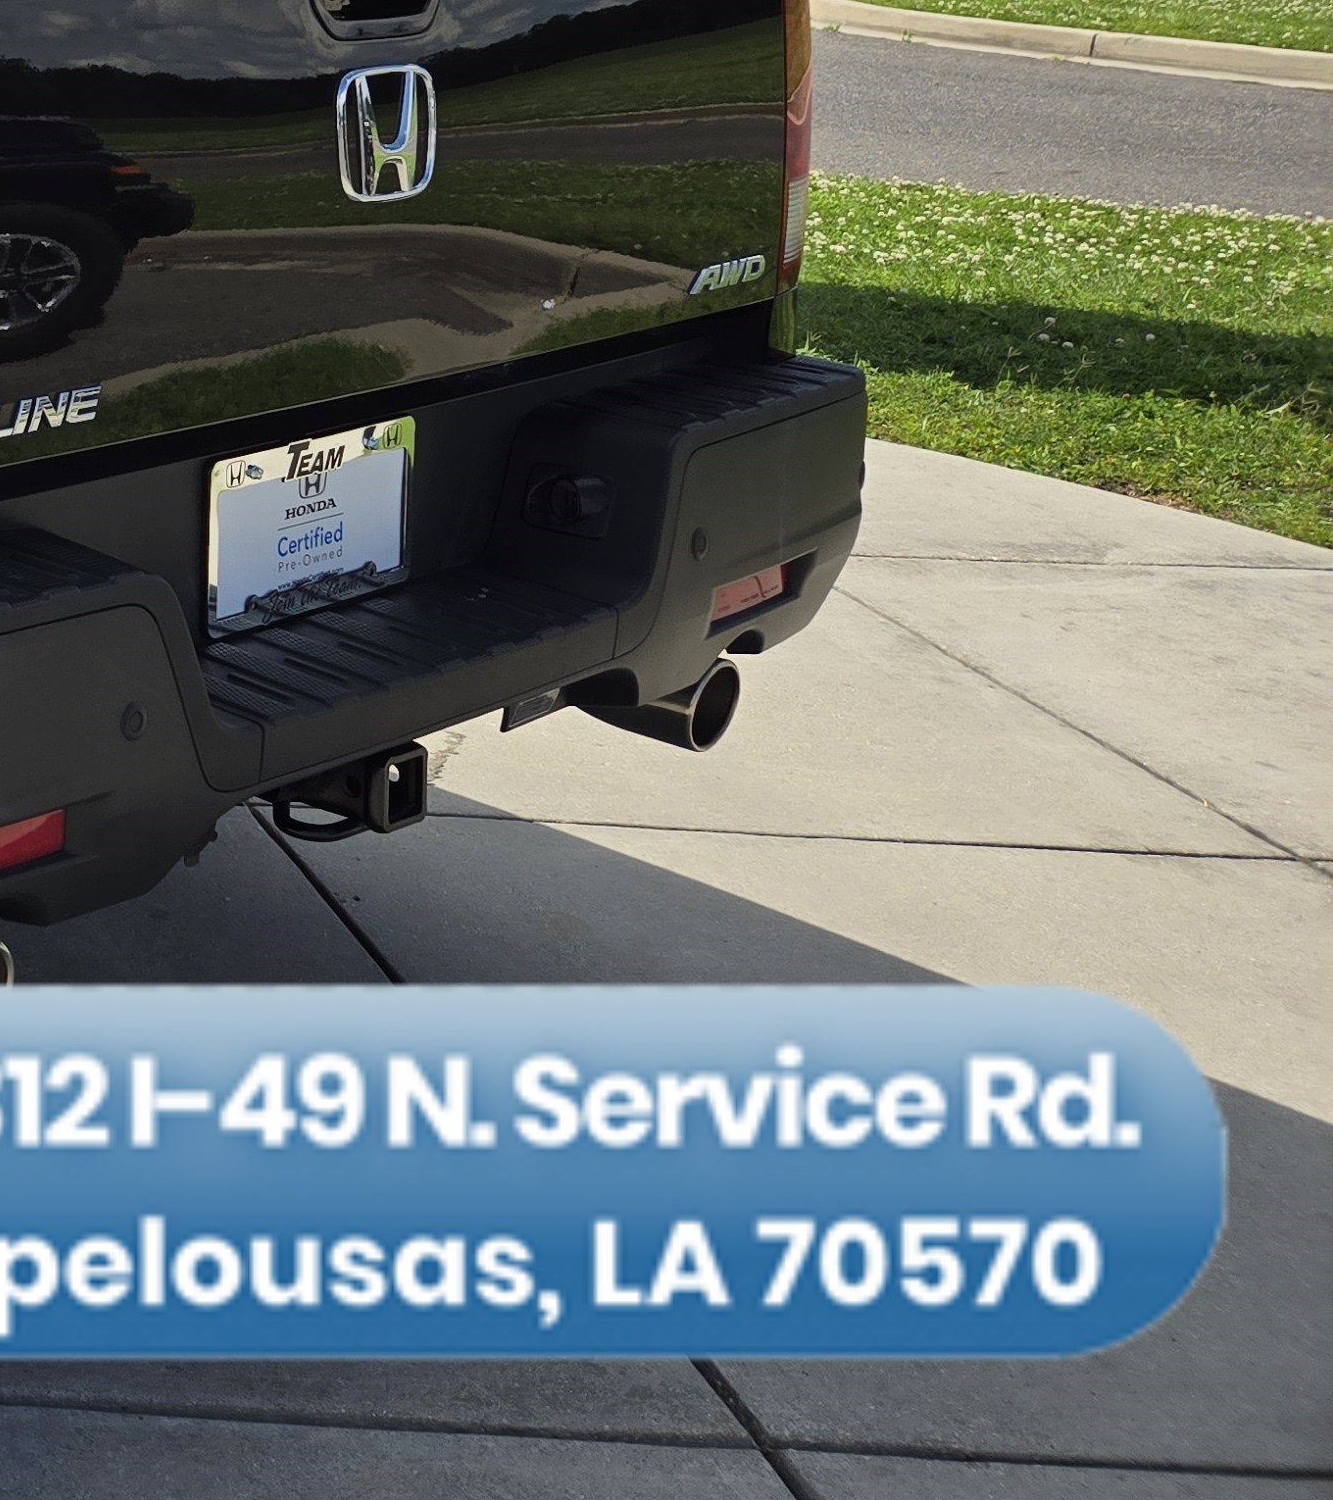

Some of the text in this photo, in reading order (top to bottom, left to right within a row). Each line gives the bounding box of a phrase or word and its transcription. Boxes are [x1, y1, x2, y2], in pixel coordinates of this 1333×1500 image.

[689, 254, 766, 296] AWD
[285, 440, 346, 482] TEAM
[285, 498, 337, 520] HONDA
[277, 521, 343, 558] Certified
[277, 547, 343, 573] Pre-Owned
